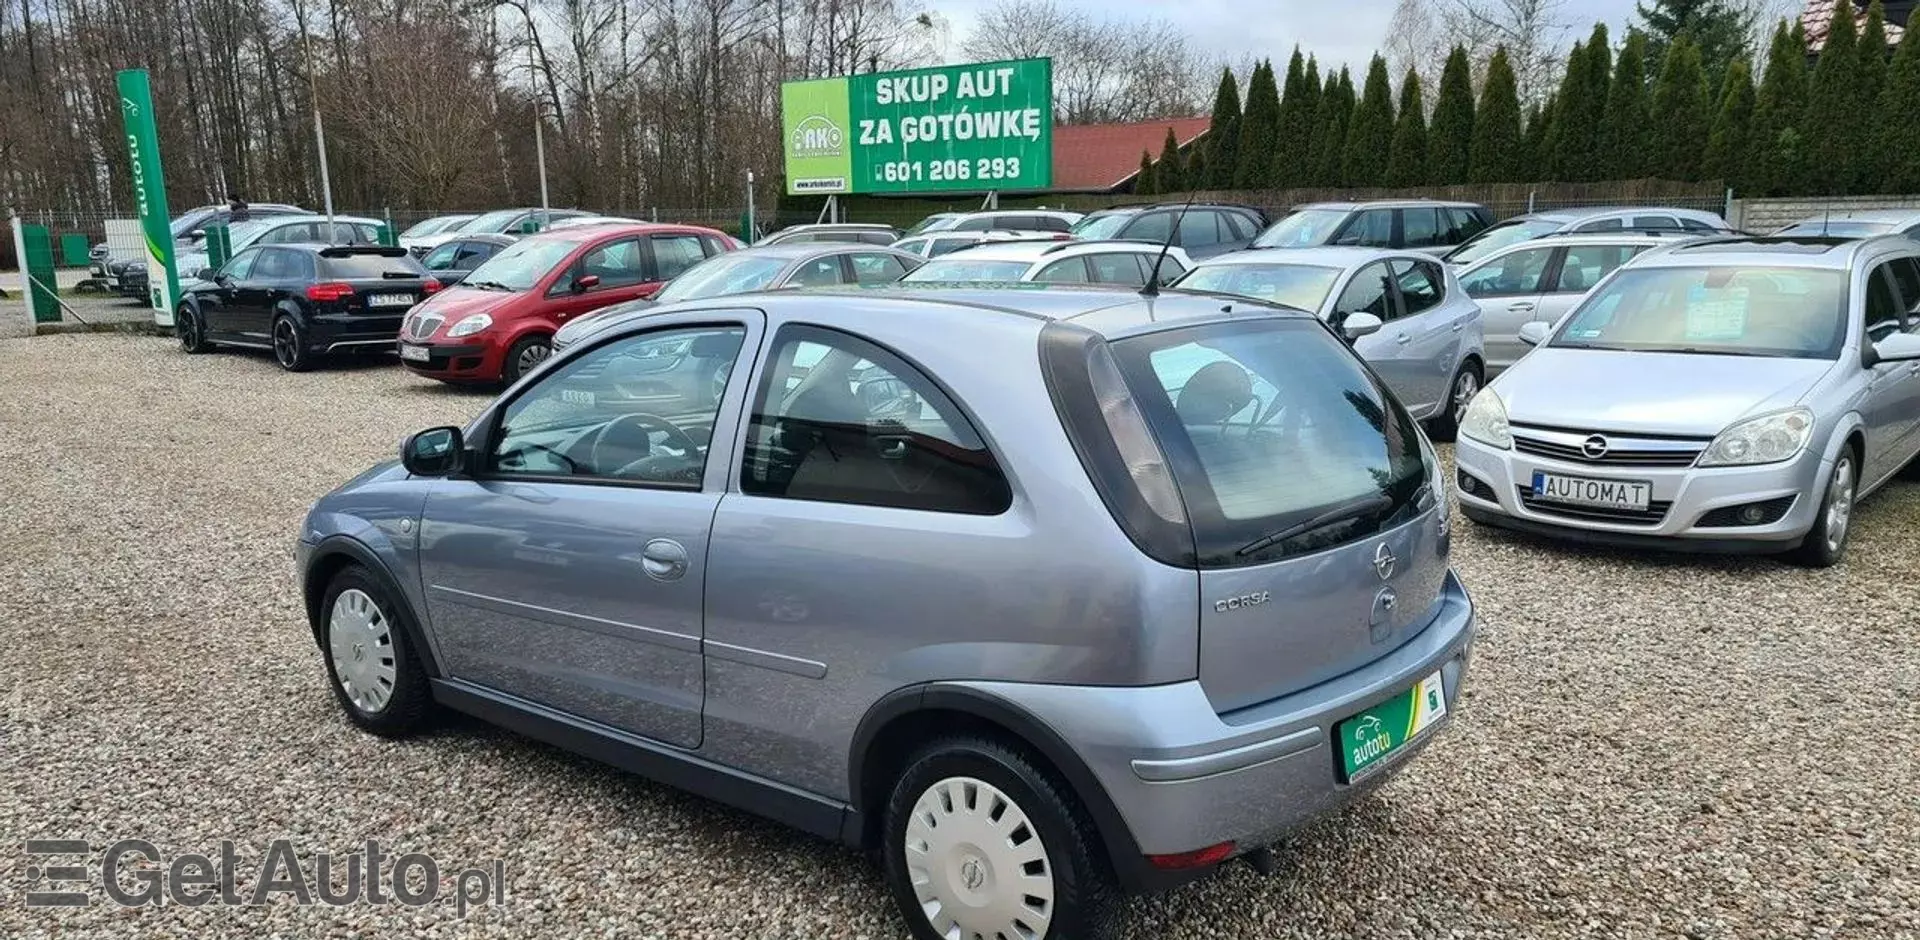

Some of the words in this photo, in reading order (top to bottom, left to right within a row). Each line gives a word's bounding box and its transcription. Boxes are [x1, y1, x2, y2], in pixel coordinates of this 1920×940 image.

[876, 74, 948, 104] SKUP
[956, 68, 1014, 99] AUT
[859, 119, 893, 145] ZA
[900, 105, 1041, 142] GOTÓWKĘ
[128, 134, 148, 216] autotu
[884, 161, 922, 182] 601
[929, 159, 970, 181] 206
[976, 157, 1020, 179] 293
[1546, 477, 1644, 503] AUTOMAT
[1214, 590, 1270, 613] CORSA
[1353, 731, 1391, 766] autotu
